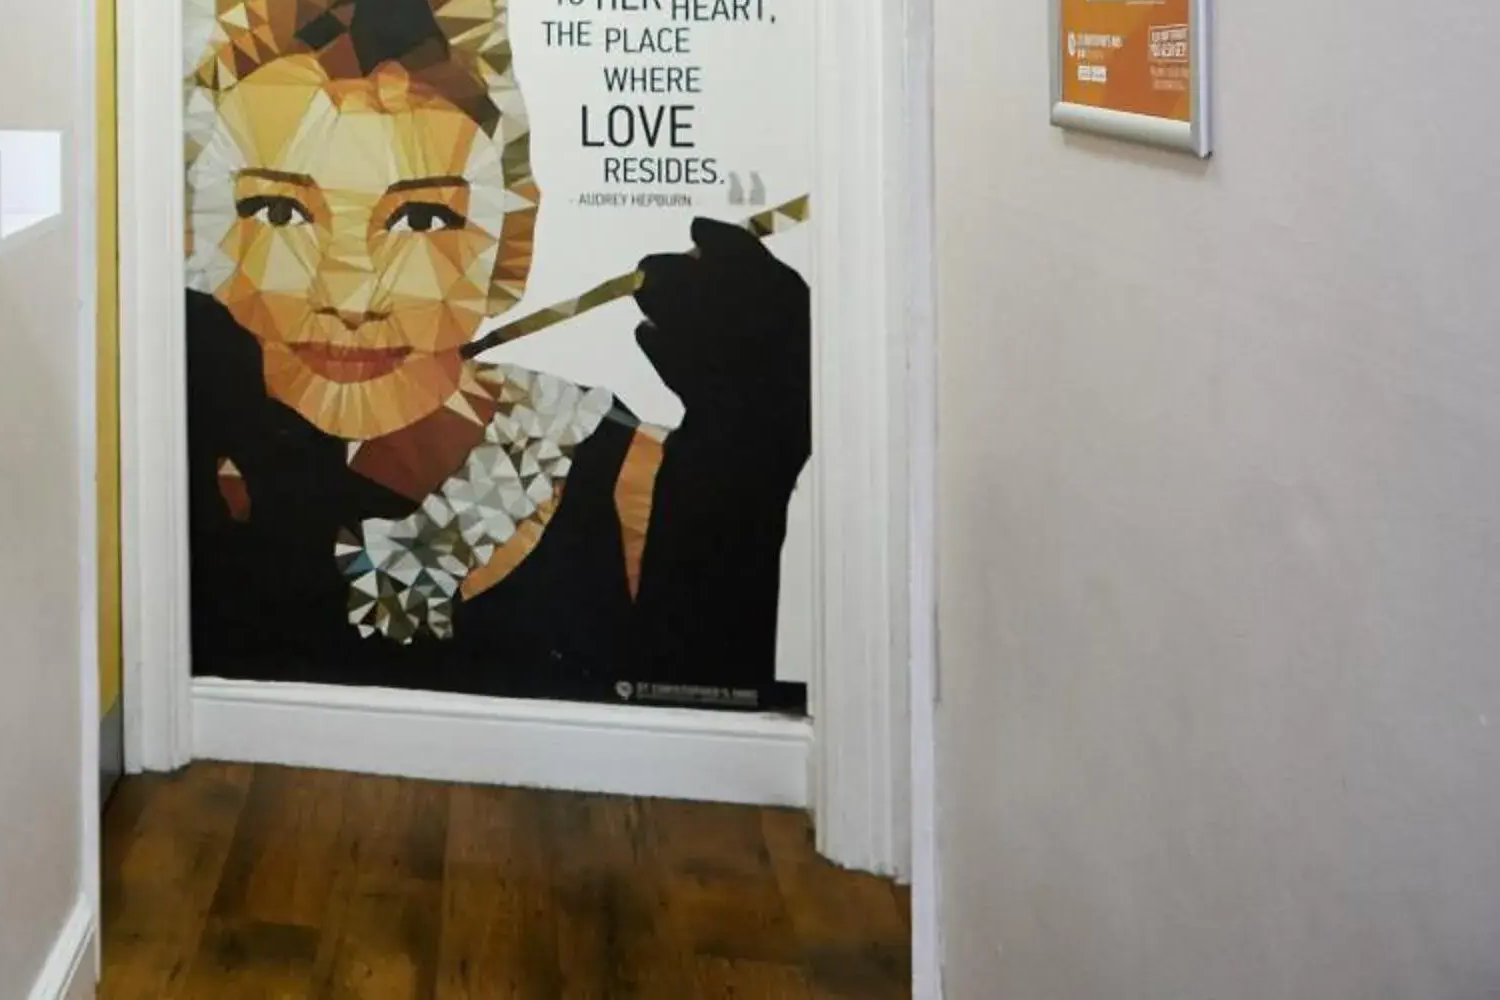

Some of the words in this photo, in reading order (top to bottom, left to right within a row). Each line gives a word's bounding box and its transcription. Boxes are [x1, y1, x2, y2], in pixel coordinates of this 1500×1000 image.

[540, 19, 593, 48] THE
[604, 26, 692, 55] PLACE
[602, 64, 703, 95] WHERE
[580, 103, 697, 150] LOVE
[603, 156, 726, 185] RESIDES.
[631, 193, 692, 207] HEPBURN
